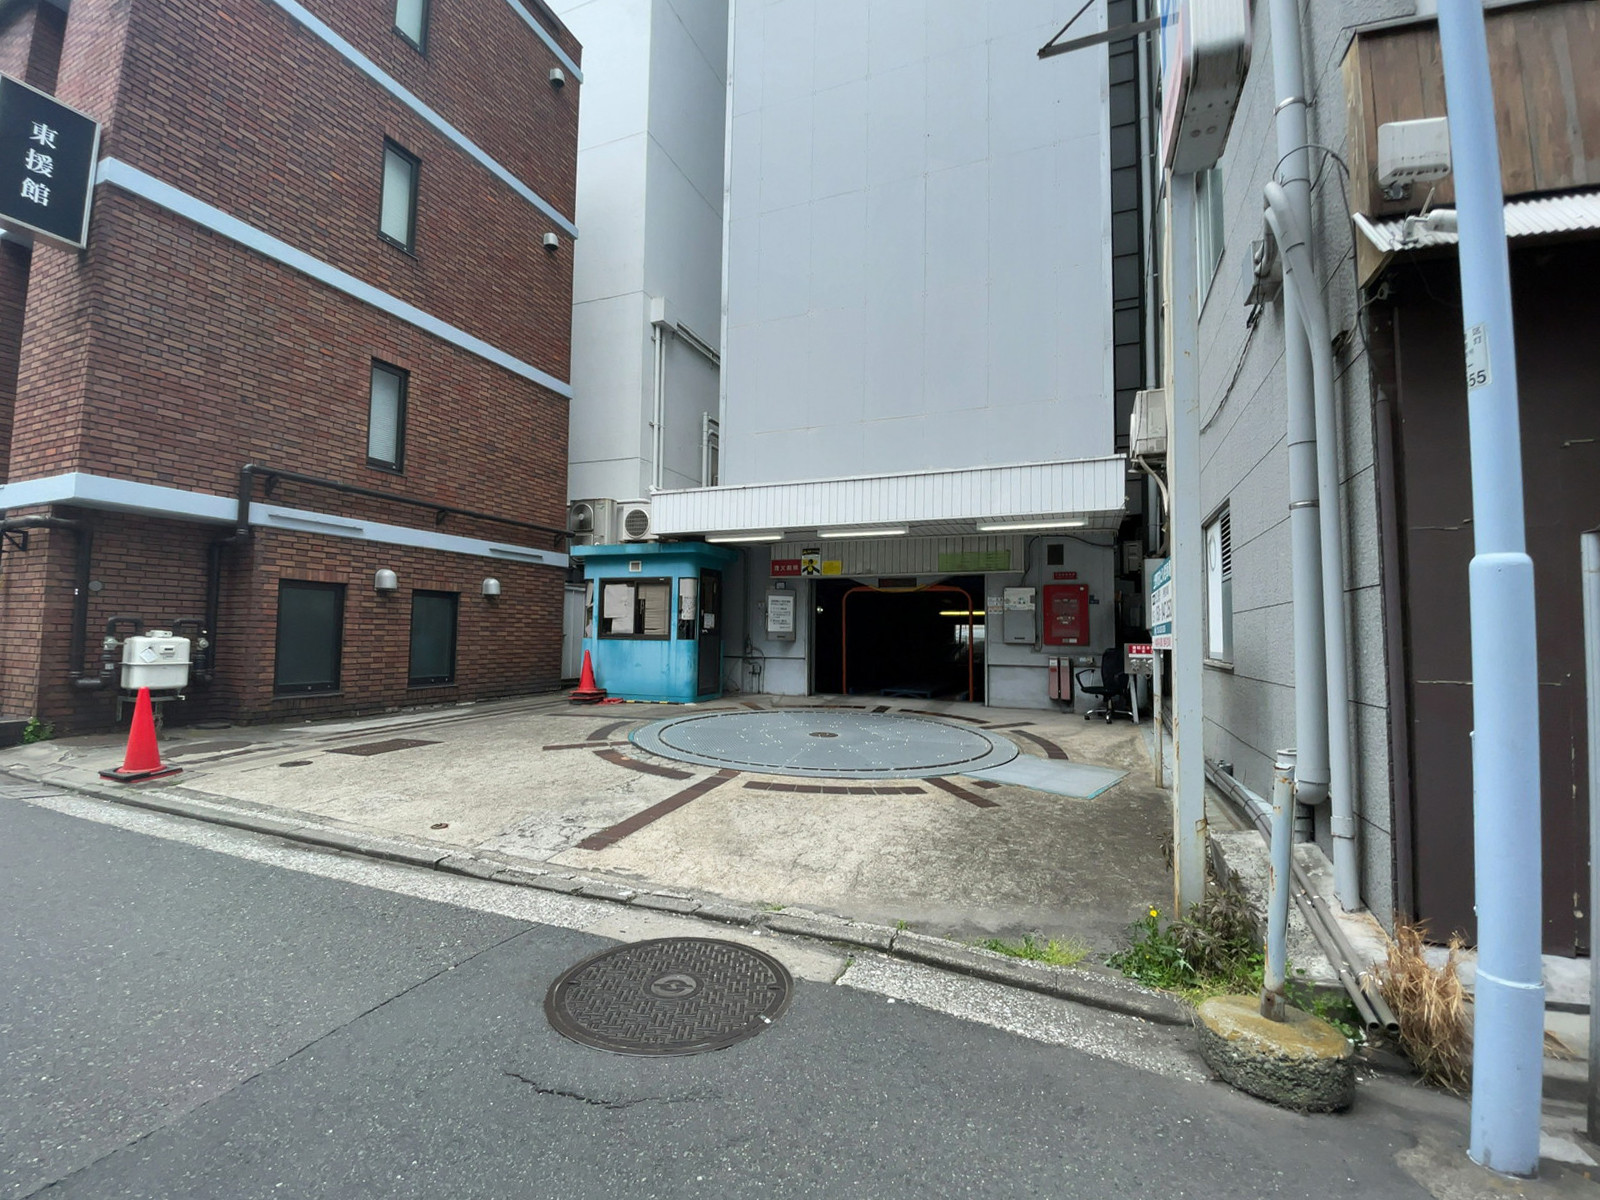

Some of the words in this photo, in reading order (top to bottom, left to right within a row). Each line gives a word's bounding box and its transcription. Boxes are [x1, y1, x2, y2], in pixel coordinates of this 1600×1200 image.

[20, 120, 59, 207] 東援館
[1468, 369, 1488, 387] 55
